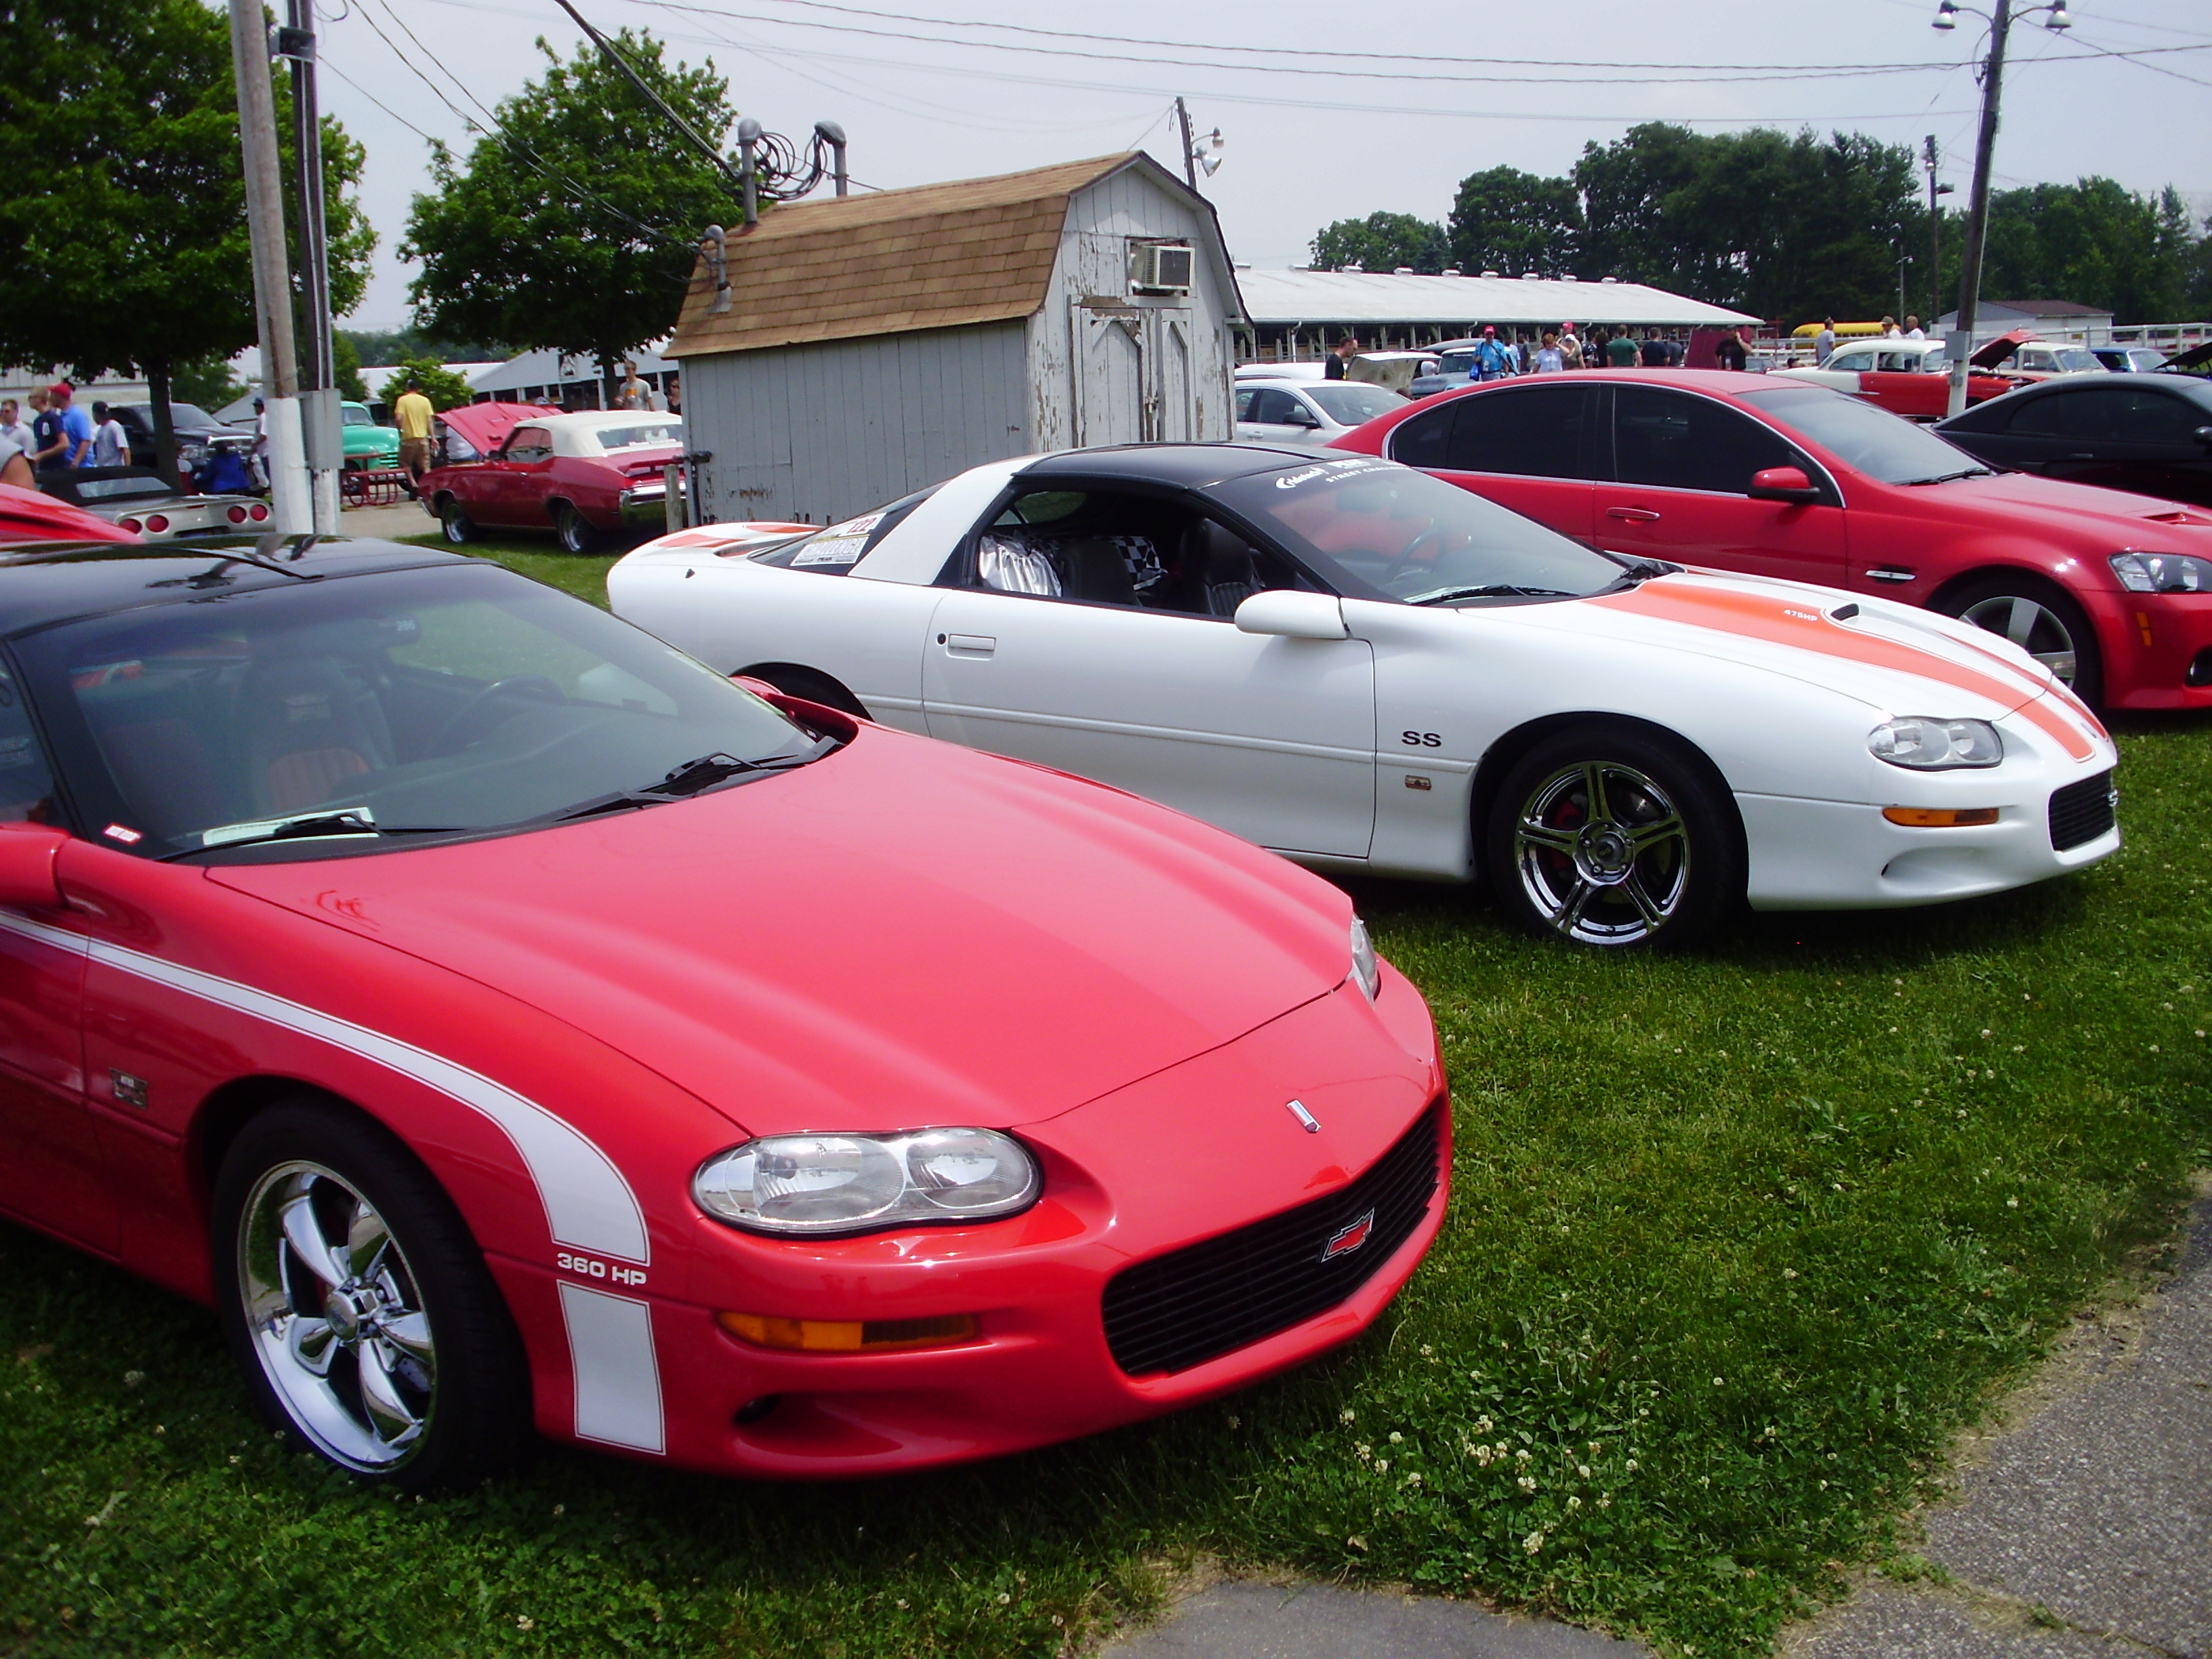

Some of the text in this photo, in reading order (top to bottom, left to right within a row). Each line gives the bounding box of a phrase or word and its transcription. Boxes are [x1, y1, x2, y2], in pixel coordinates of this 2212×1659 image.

[1326, 470, 1361, 483] STREET
[847, 517, 877, 533] 122
[798, 538, 863, 558] CHALLENGE
[1401, 731, 1441, 747] SS
[557, 1252, 647, 1286] 360 HP
